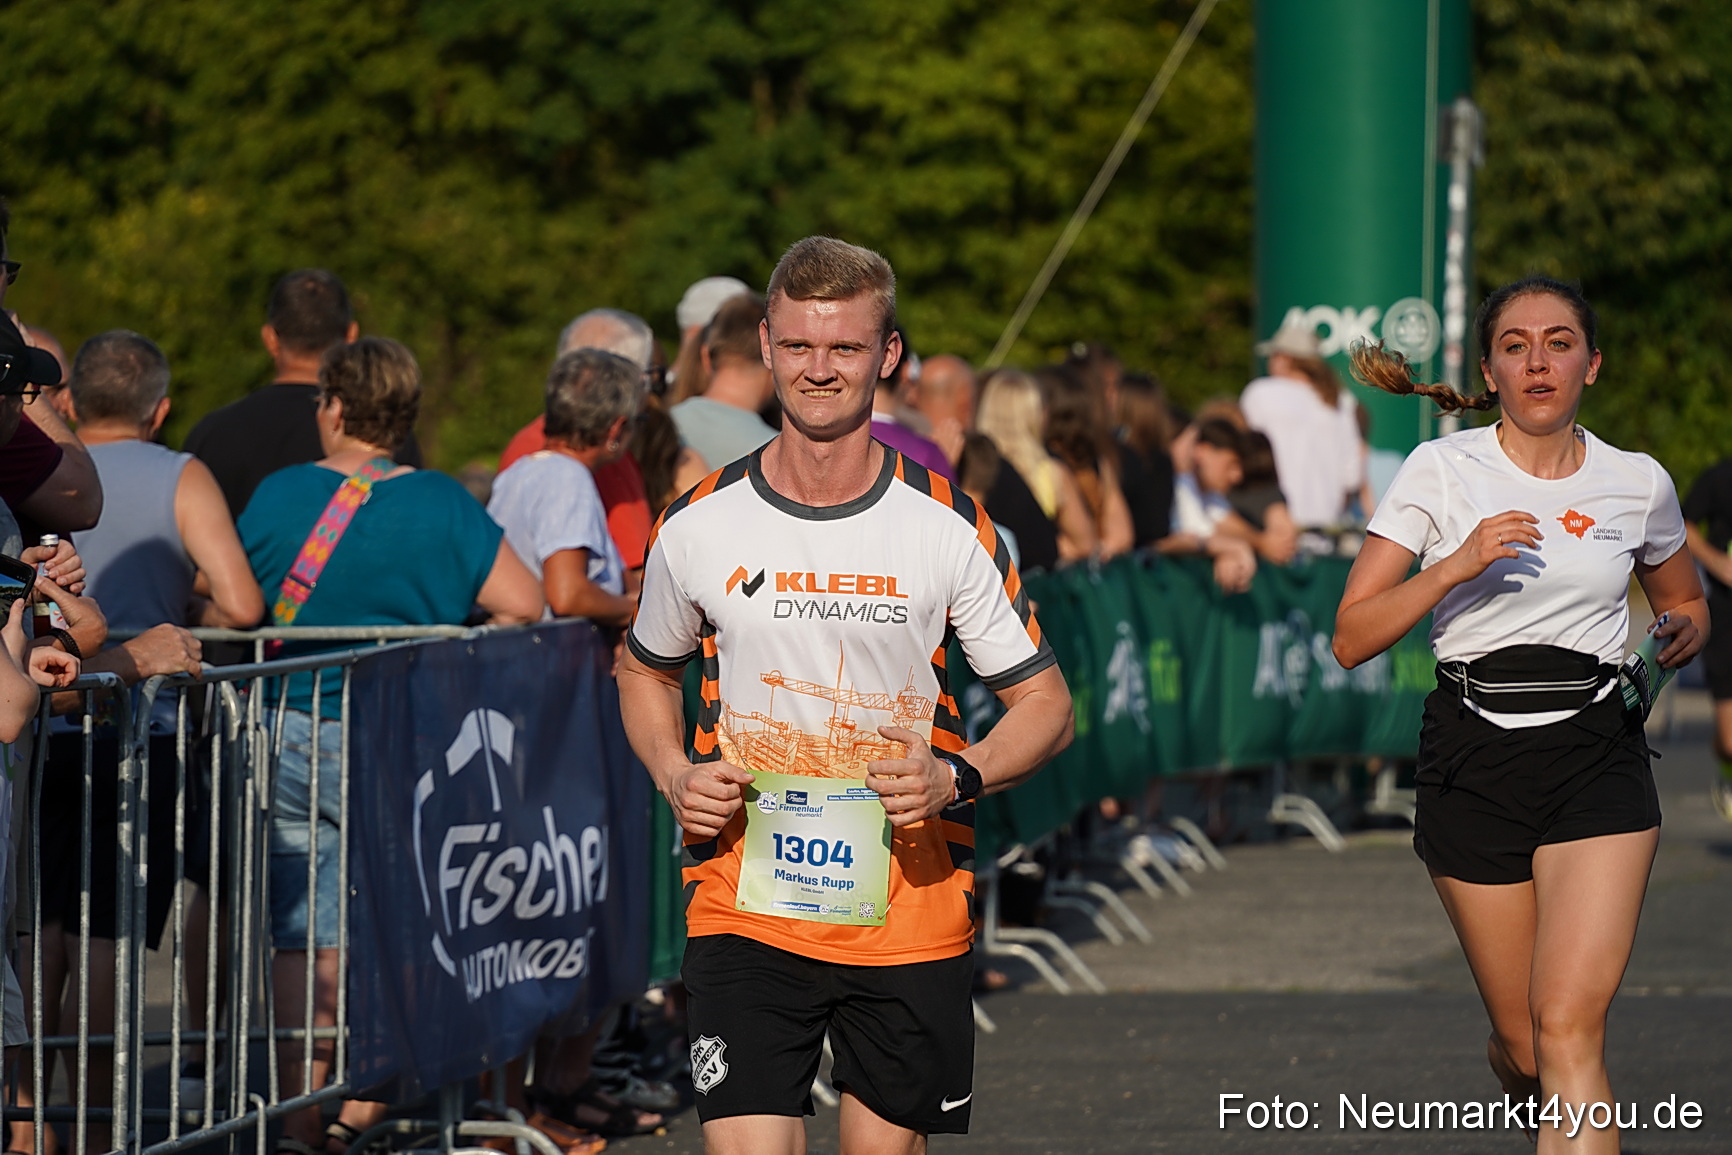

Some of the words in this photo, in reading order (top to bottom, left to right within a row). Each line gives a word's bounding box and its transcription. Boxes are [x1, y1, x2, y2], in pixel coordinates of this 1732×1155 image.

[1569, 519, 1583, 528] NM
[1592, 528, 1622, 536] LANDKREIS
[775, 572, 909, 599] KLEBL
[773, 600, 908, 624] DYNAMICS
[779, 803, 824, 813] Firmenlauf
[772, 832, 854, 869] 1304
[774, 868, 819, 887] Markus
[821, 876, 855, 892] Rupp
[701, 1061, 719, 1086] SV
